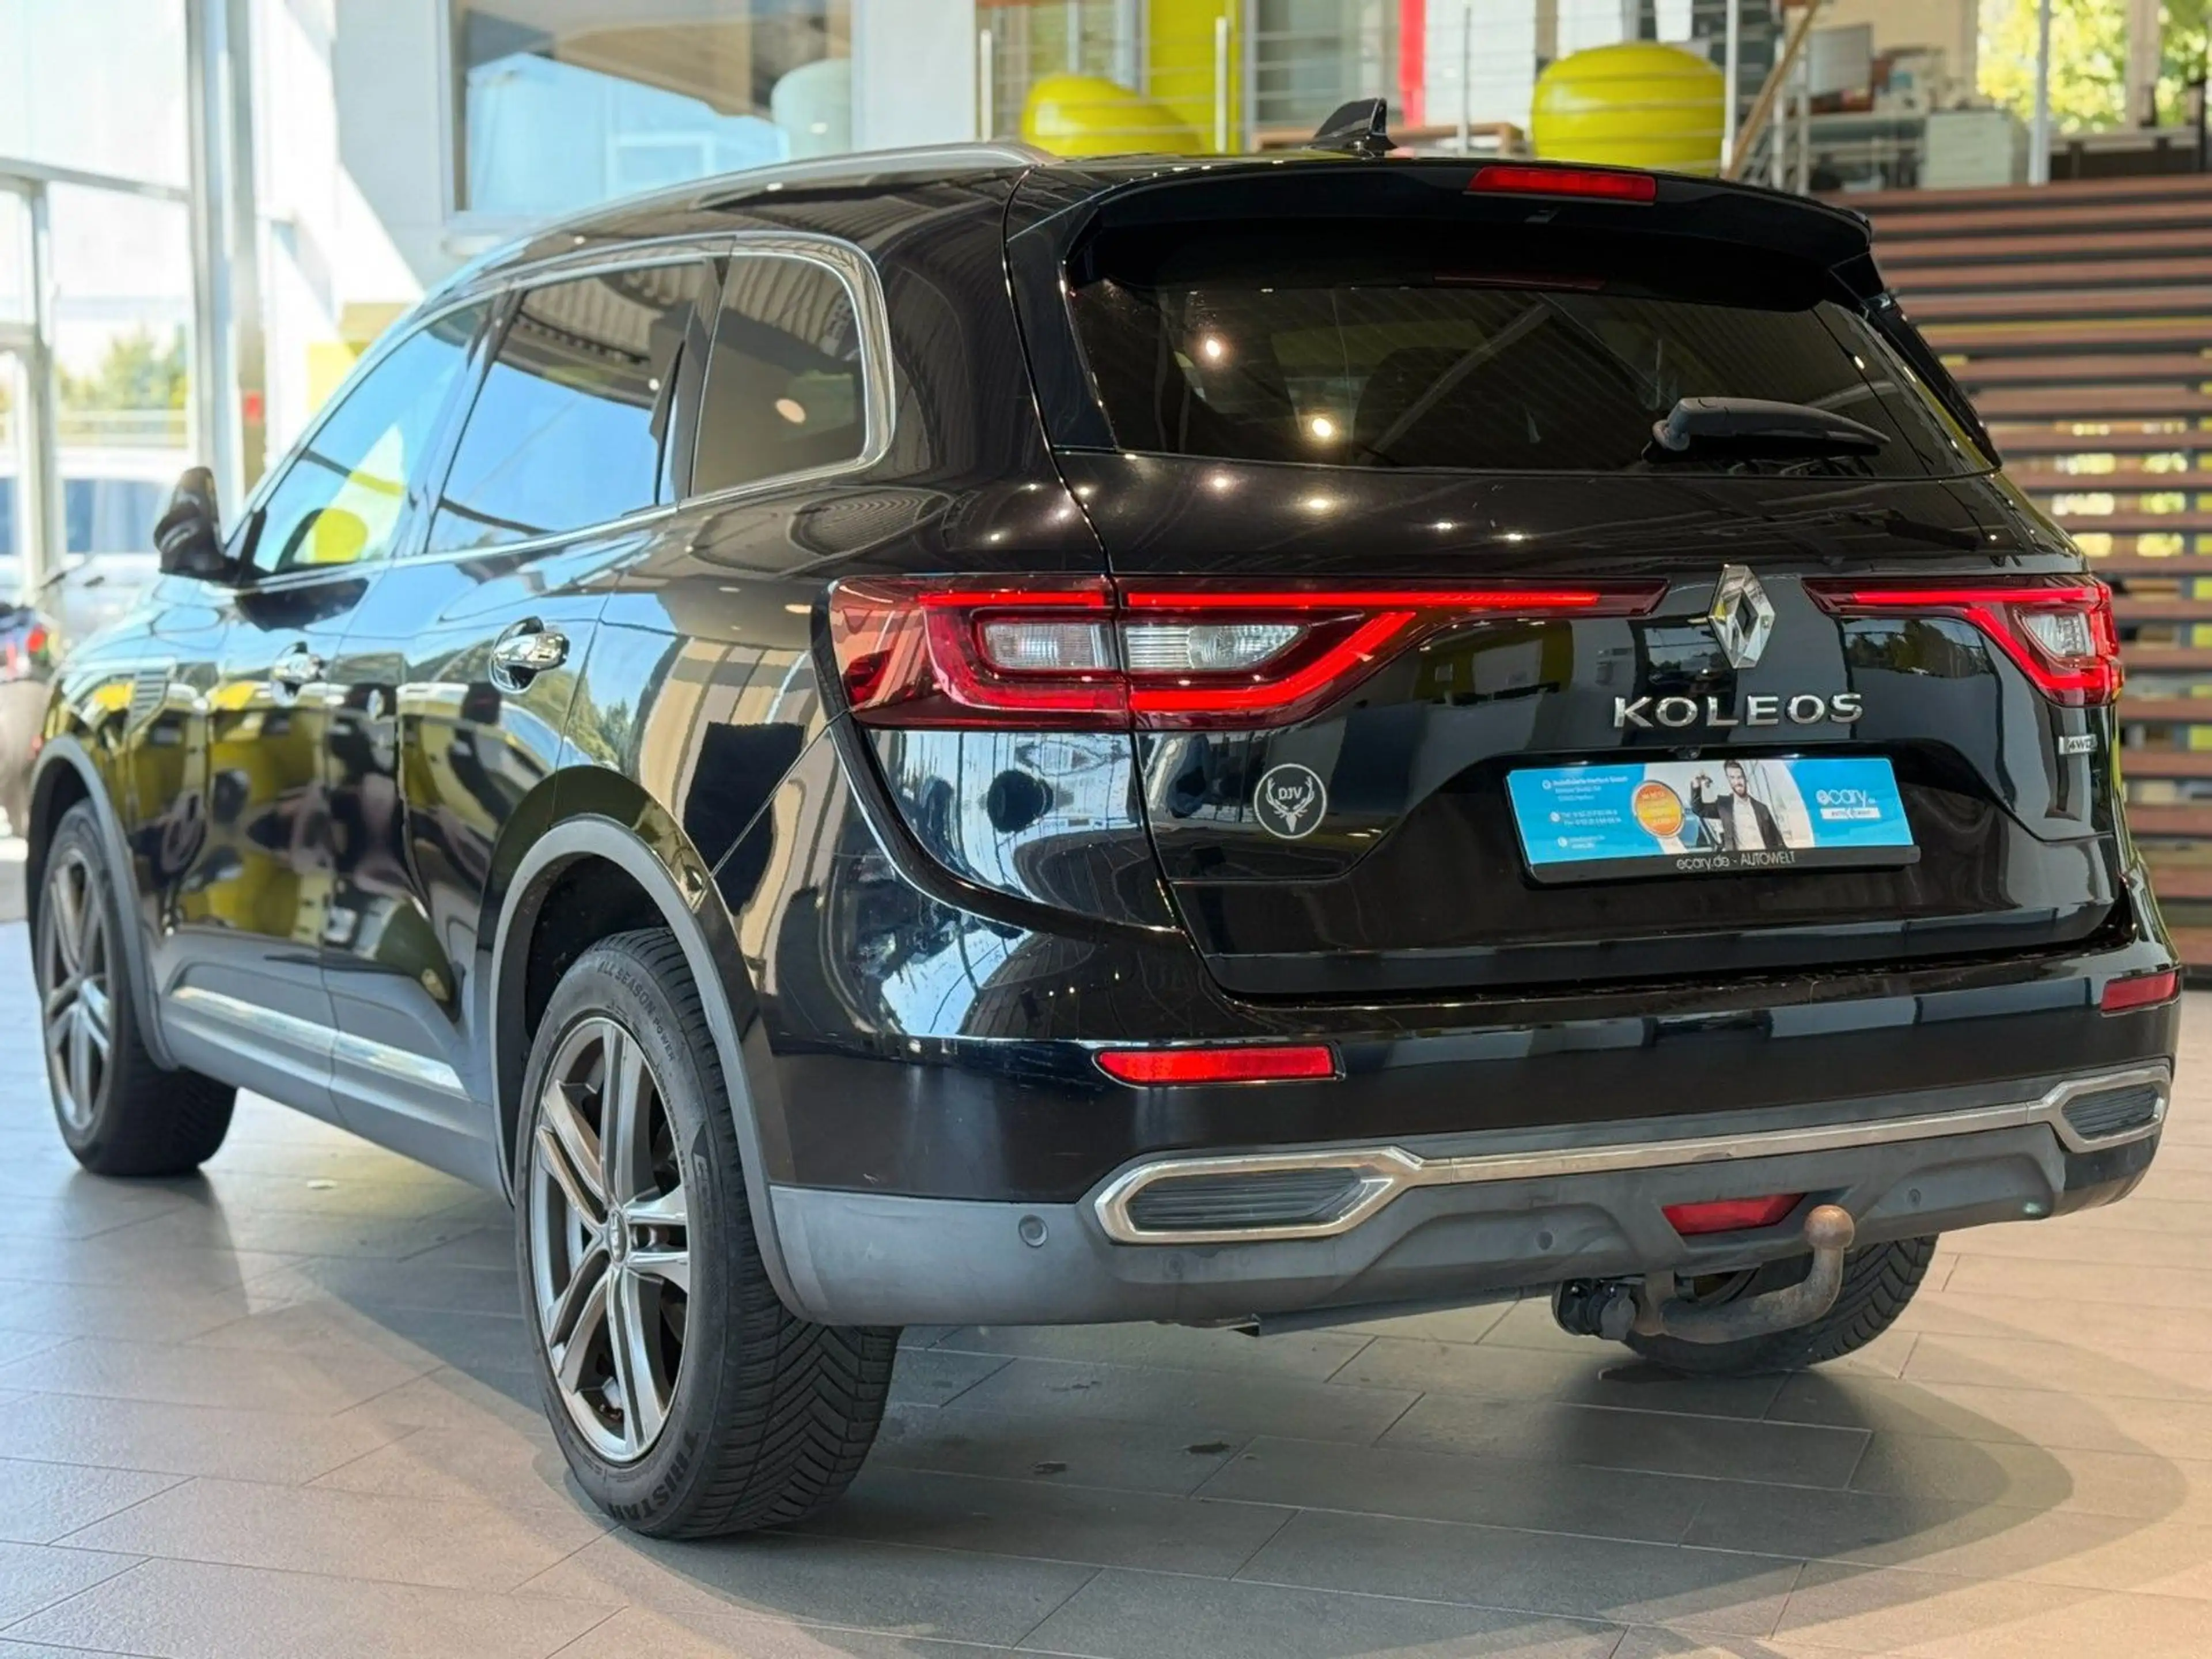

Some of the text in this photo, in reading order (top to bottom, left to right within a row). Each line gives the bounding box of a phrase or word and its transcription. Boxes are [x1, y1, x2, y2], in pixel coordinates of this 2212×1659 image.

[1613, 694, 1863, 728] KOLEOS
[1278, 786, 1304, 800] DJV
[1740, 850, 1796, 866] AUTOWELT
[614, 967, 657, 1015] SEASON
[652, 1017, 676, 1062] POWER
